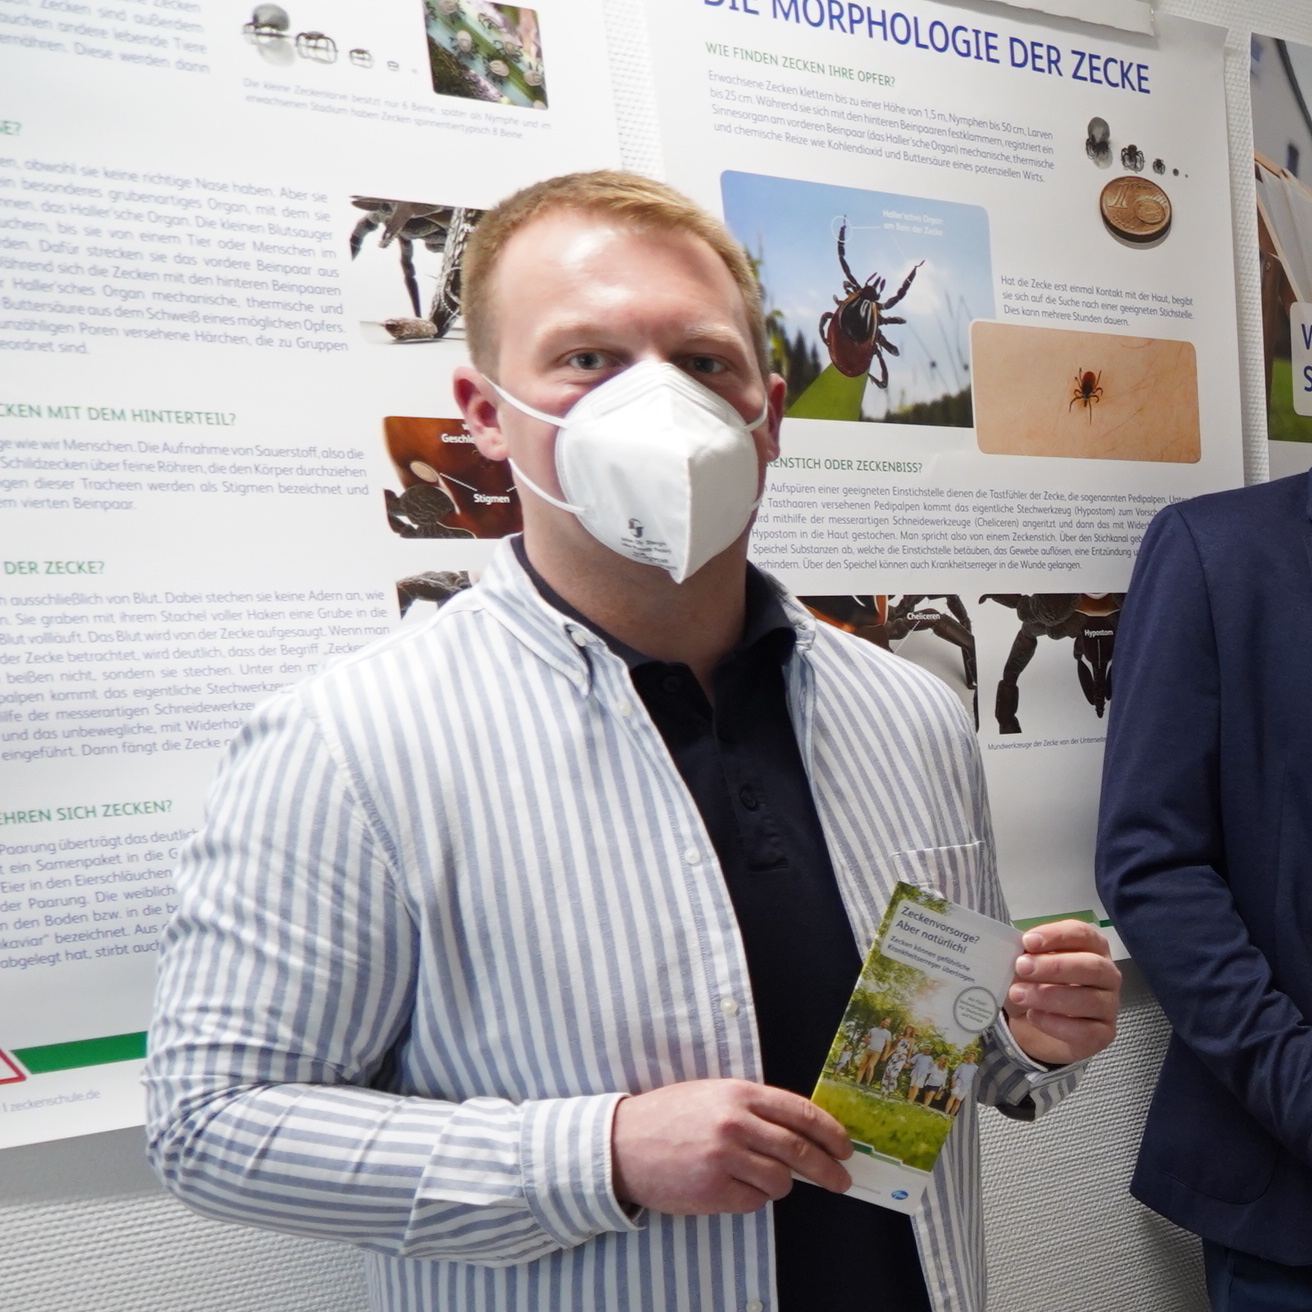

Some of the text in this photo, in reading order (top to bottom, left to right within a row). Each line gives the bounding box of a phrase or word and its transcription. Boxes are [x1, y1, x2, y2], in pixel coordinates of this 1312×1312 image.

[772, 0, 1150, 93] MORPHOLOGIE DER ZECKE
[705, 42, 894, 87] WIE FINDEN ZECKEN IHRE OPFER?
[714, 123, 1044, 182] und chemische Reize wie Kohlendioxid und Buttersäure eines potenziellen Wirts.
[1000, 275, 1192, 307] Hat die Zecke erst einmal Kontakt mit der Haut, begibt
[1002, 291, 1193, 319] sie sich auf die Suche nach einer geeigneten Stichstelle.
[1003, 304, 1129, 326] Dies kann mehrere Stunden dauern.
[47, 405, 80, 419] MIT
[87, 406, 126, 421] DEM
[131, 409, 235, 425] HINTERTEIL?
[824, 458, 853, 470] ODER
[856, 460, 922, 472] ZECKENBISS?
[473, 493, 510, 505] Stigmen
[752, 543, 1131, 558] Speichel Substanzen ab, welche die Einstichstelle betäuben, das Gewebe auflösen, eine Entzündung
[3, 560, 104, 574] DER ZECKE?
[802, 559, 823, 568] Über
[825, 559, 841, 568] den
[842, 558, 877, 571] Speichel
[878, 559, 908, 568] können
[910, 559, 929, 568] auch
[930, 559, 997, 571] Krankheitserreger
[998, 560, 1006, 568] in
[1007, 559, 1018, 568] die
[1020, 560, 1046, 569] Wunde
[1047, 560, 1081, 571] gelangen.
[1, 737, 220, 762] eingeführt. Dann fängt die Zecke
[56, 805, 96, 820] SICH
[101, 799, 172, 816] ZECKEN?
[901, 906, 980, 944] Zeckenvorsorge?
[890, 935, 913, 949] Zecken
[896, 920, 967, 954] Aber natürlich!
